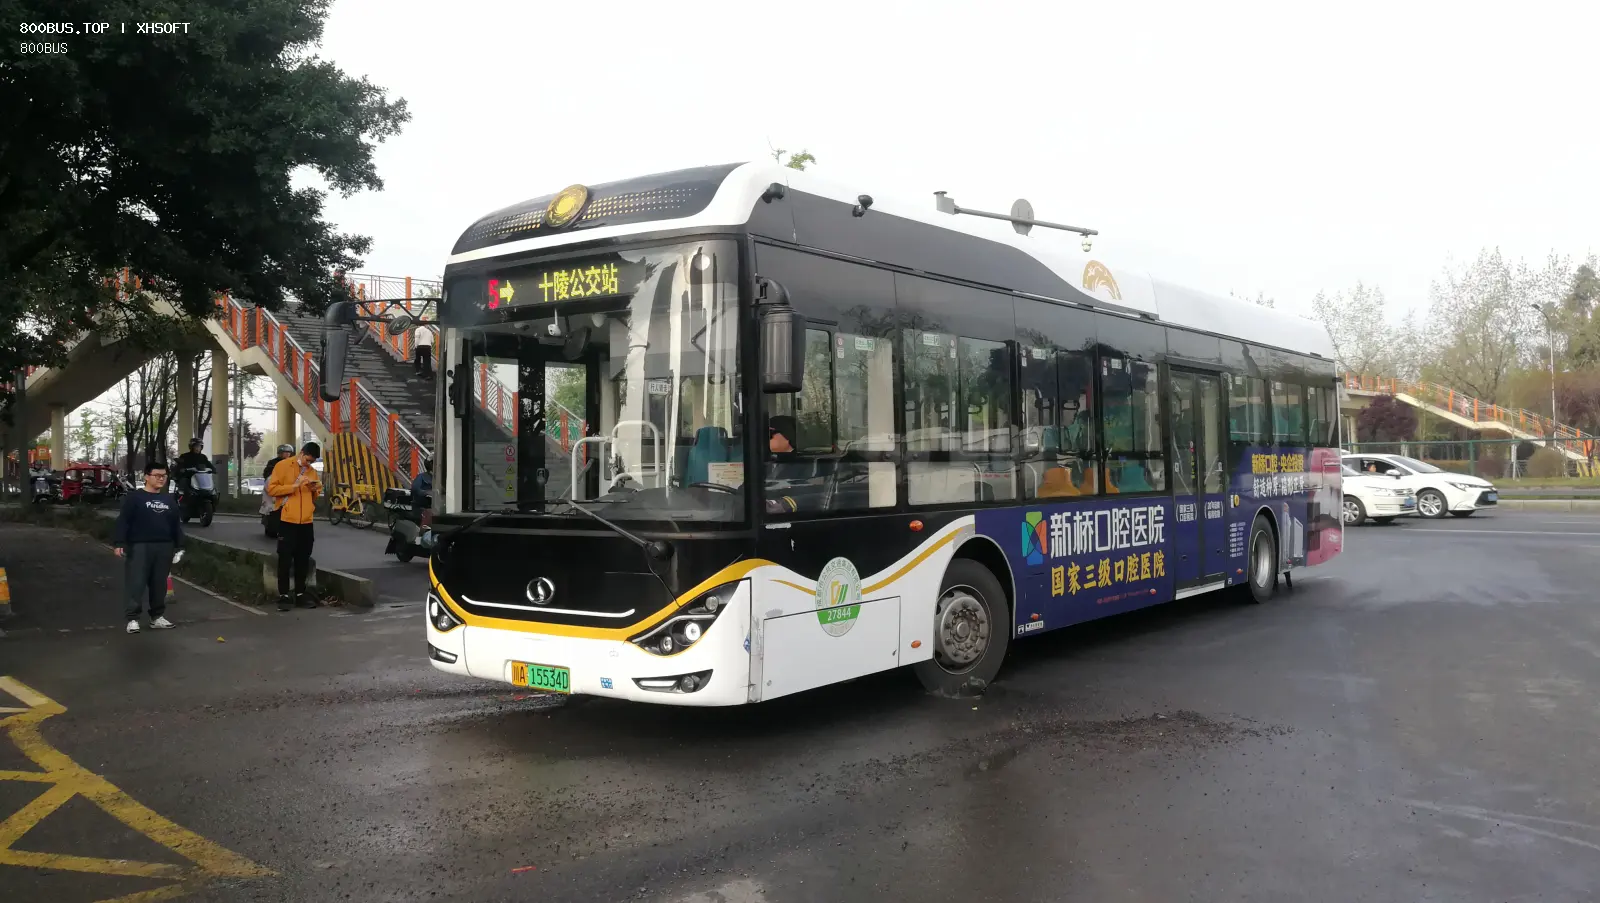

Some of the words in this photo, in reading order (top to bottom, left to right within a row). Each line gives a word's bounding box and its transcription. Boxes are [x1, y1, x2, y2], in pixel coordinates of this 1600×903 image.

[488, 279, 499, 310] 5
[538, 262, 618, 302] 十陵公交站
[1050, 504, 1165, 559] 新桥口腔医院
[1051, 550, 1166, 598] 国家三级口腔医院
[827, 607, 852, 621] 27844
